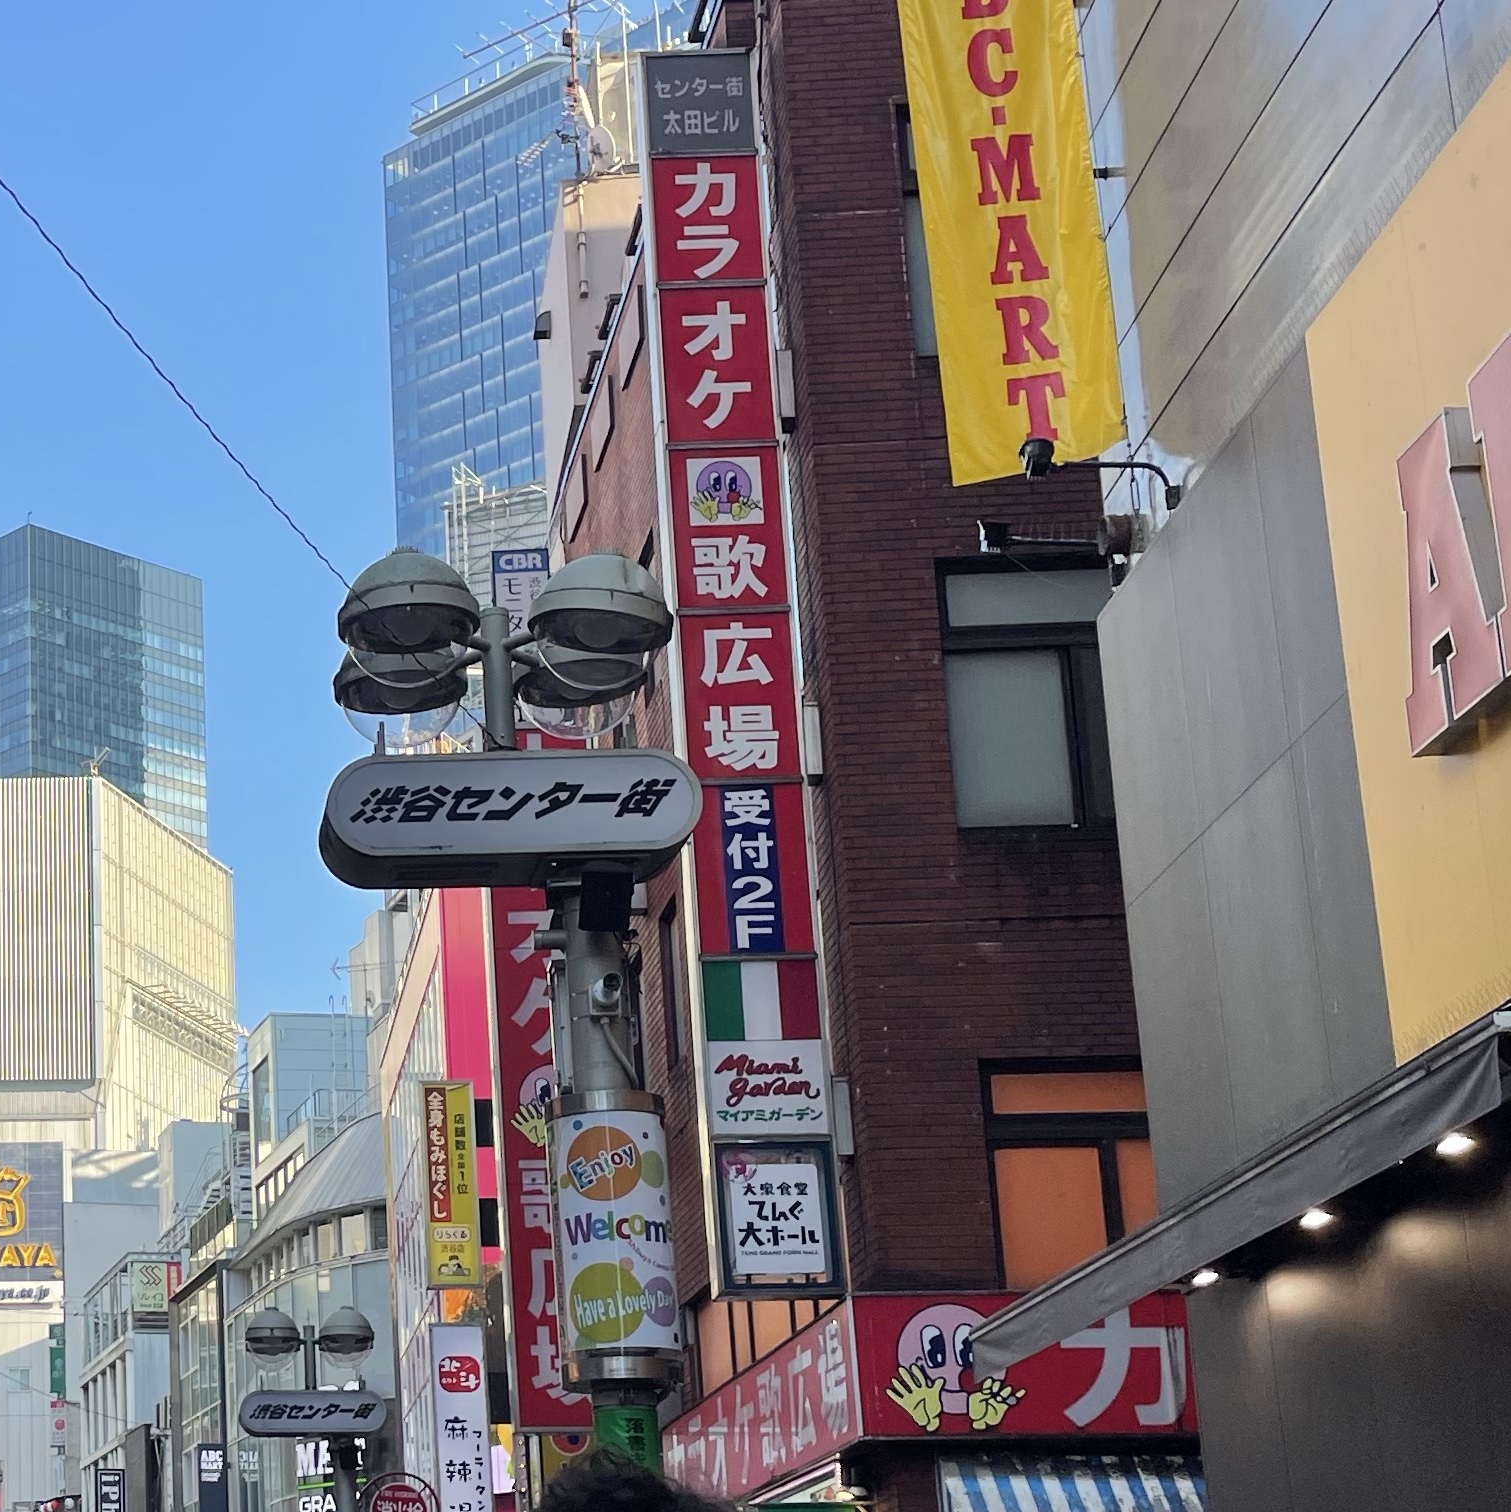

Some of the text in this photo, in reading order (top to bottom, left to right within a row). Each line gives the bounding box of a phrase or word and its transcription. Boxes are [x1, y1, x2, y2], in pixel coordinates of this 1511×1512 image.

[654, 76, 744, 99] センター街
[662, 109, 739, 136] 太田ビル
[673, 161, 752, 430] カラオケ
[498, 552, 543, 570] CBR
[690, 534, 780, 772] 歌広場
[350, 778, 678, 825] 渋谷センター街
[724, 788, 776, 950] 受付2F
[713, 1053, 803, 1078] Miami
[716, 1107, 824, 1122] マイアミガーデン
[427, 1090, 448, 1220] 全身もみほぐし
[567, 1142, 636, 1193] Enjoy
[747, 1199, 805, 1222] てんぐ
[737, 1221, 820, 1248] 大ホール
[573, 1292, 606, 1330] Have
[616, 1289, 657, 1318] Lovely
[248, 1402, 378, 1420] 渋谷センター街
[200, 1450, 224, 1462] ABC
[472, 1429, 486, 1512] マーラータン
